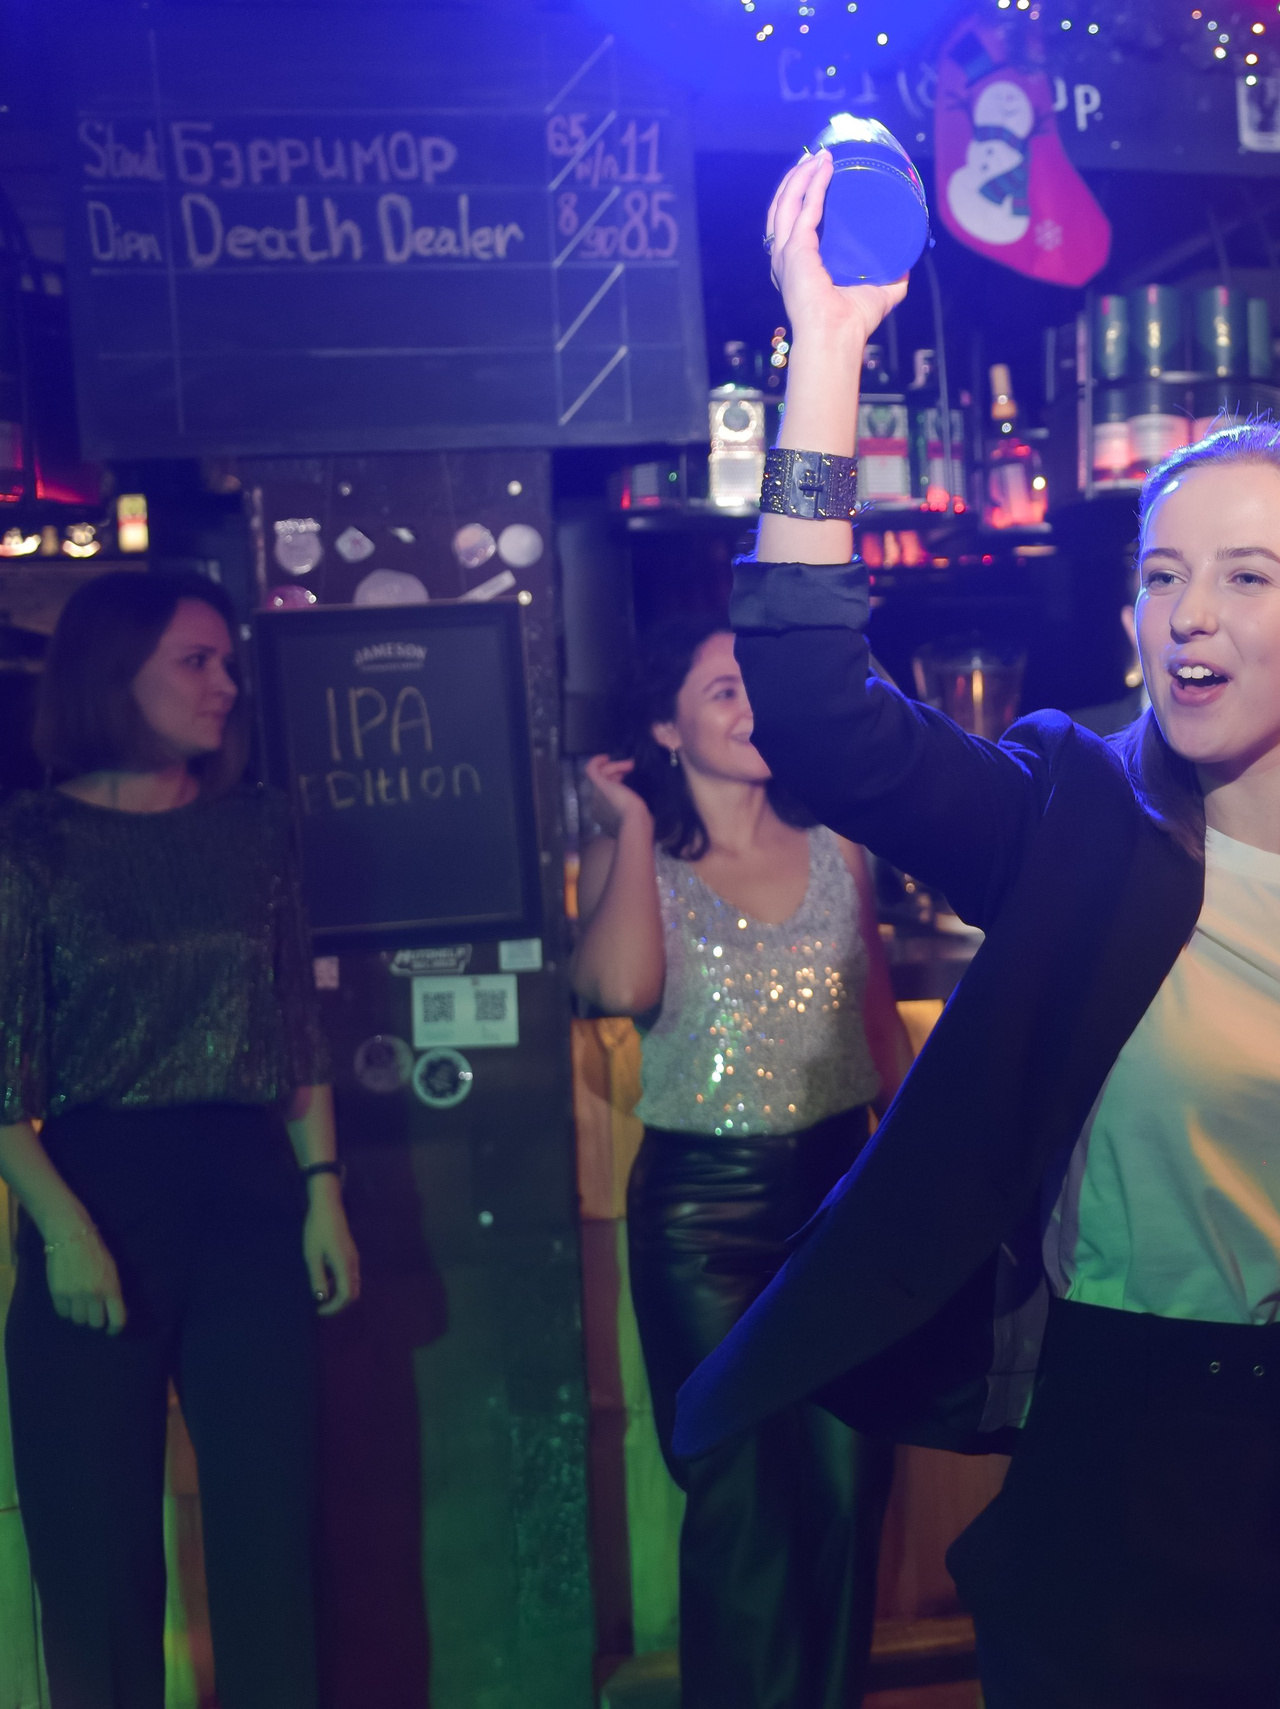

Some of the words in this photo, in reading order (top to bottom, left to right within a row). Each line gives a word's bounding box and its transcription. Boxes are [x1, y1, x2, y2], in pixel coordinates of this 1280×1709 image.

[619, 120, 664, 183] 11
[180, 193, 363, 269] Death
[377, 193, 525, 264] Dealer
[557, 191, 579, 236] 8
[354, 642, 428, 667] JAMESON
[326, 685, 433, 763] IPA
